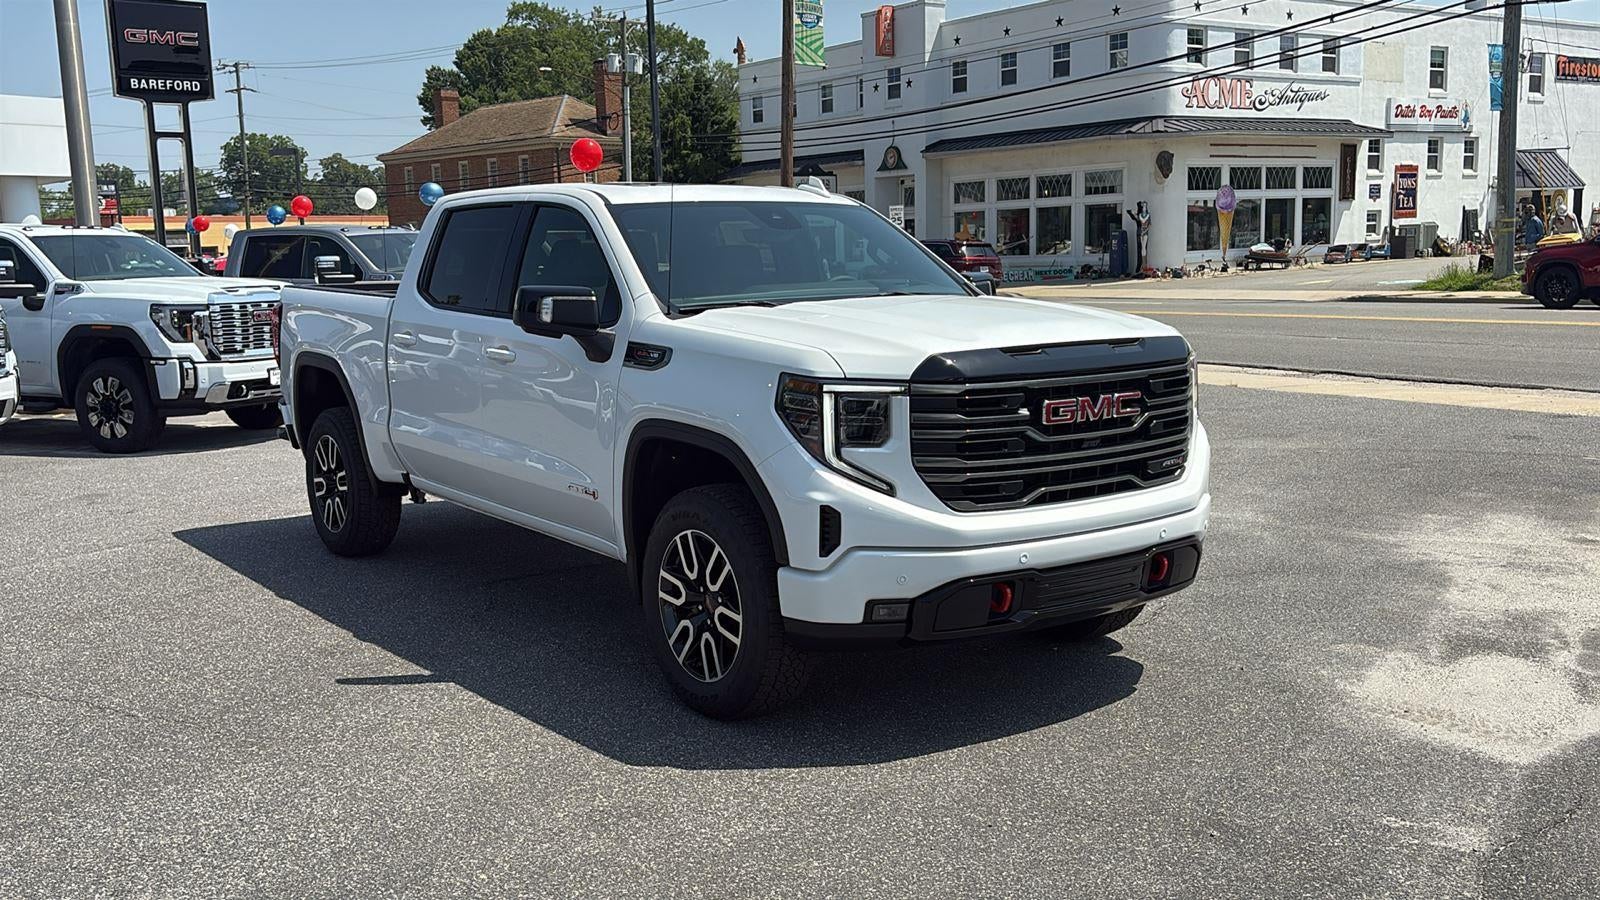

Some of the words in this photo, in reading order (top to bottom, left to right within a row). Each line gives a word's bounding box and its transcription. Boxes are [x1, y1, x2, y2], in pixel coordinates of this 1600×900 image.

[124, 28, 199, 46] GMC
[1557, 55, 1600, 77] Firesto
[130, 78, 201, 91] BAREFORD
[1181, 76, 1254, 109] ACME
[1394, 103, 1416, 119] Dutch
[1418, 104, 1434, 122] Boy
[1434, 104, 1460, 119] Paints
[891, 217, 903, 226] 25
[1042, 391, 1141, 425] GMC
[567, 482, 599, 501] AT4
